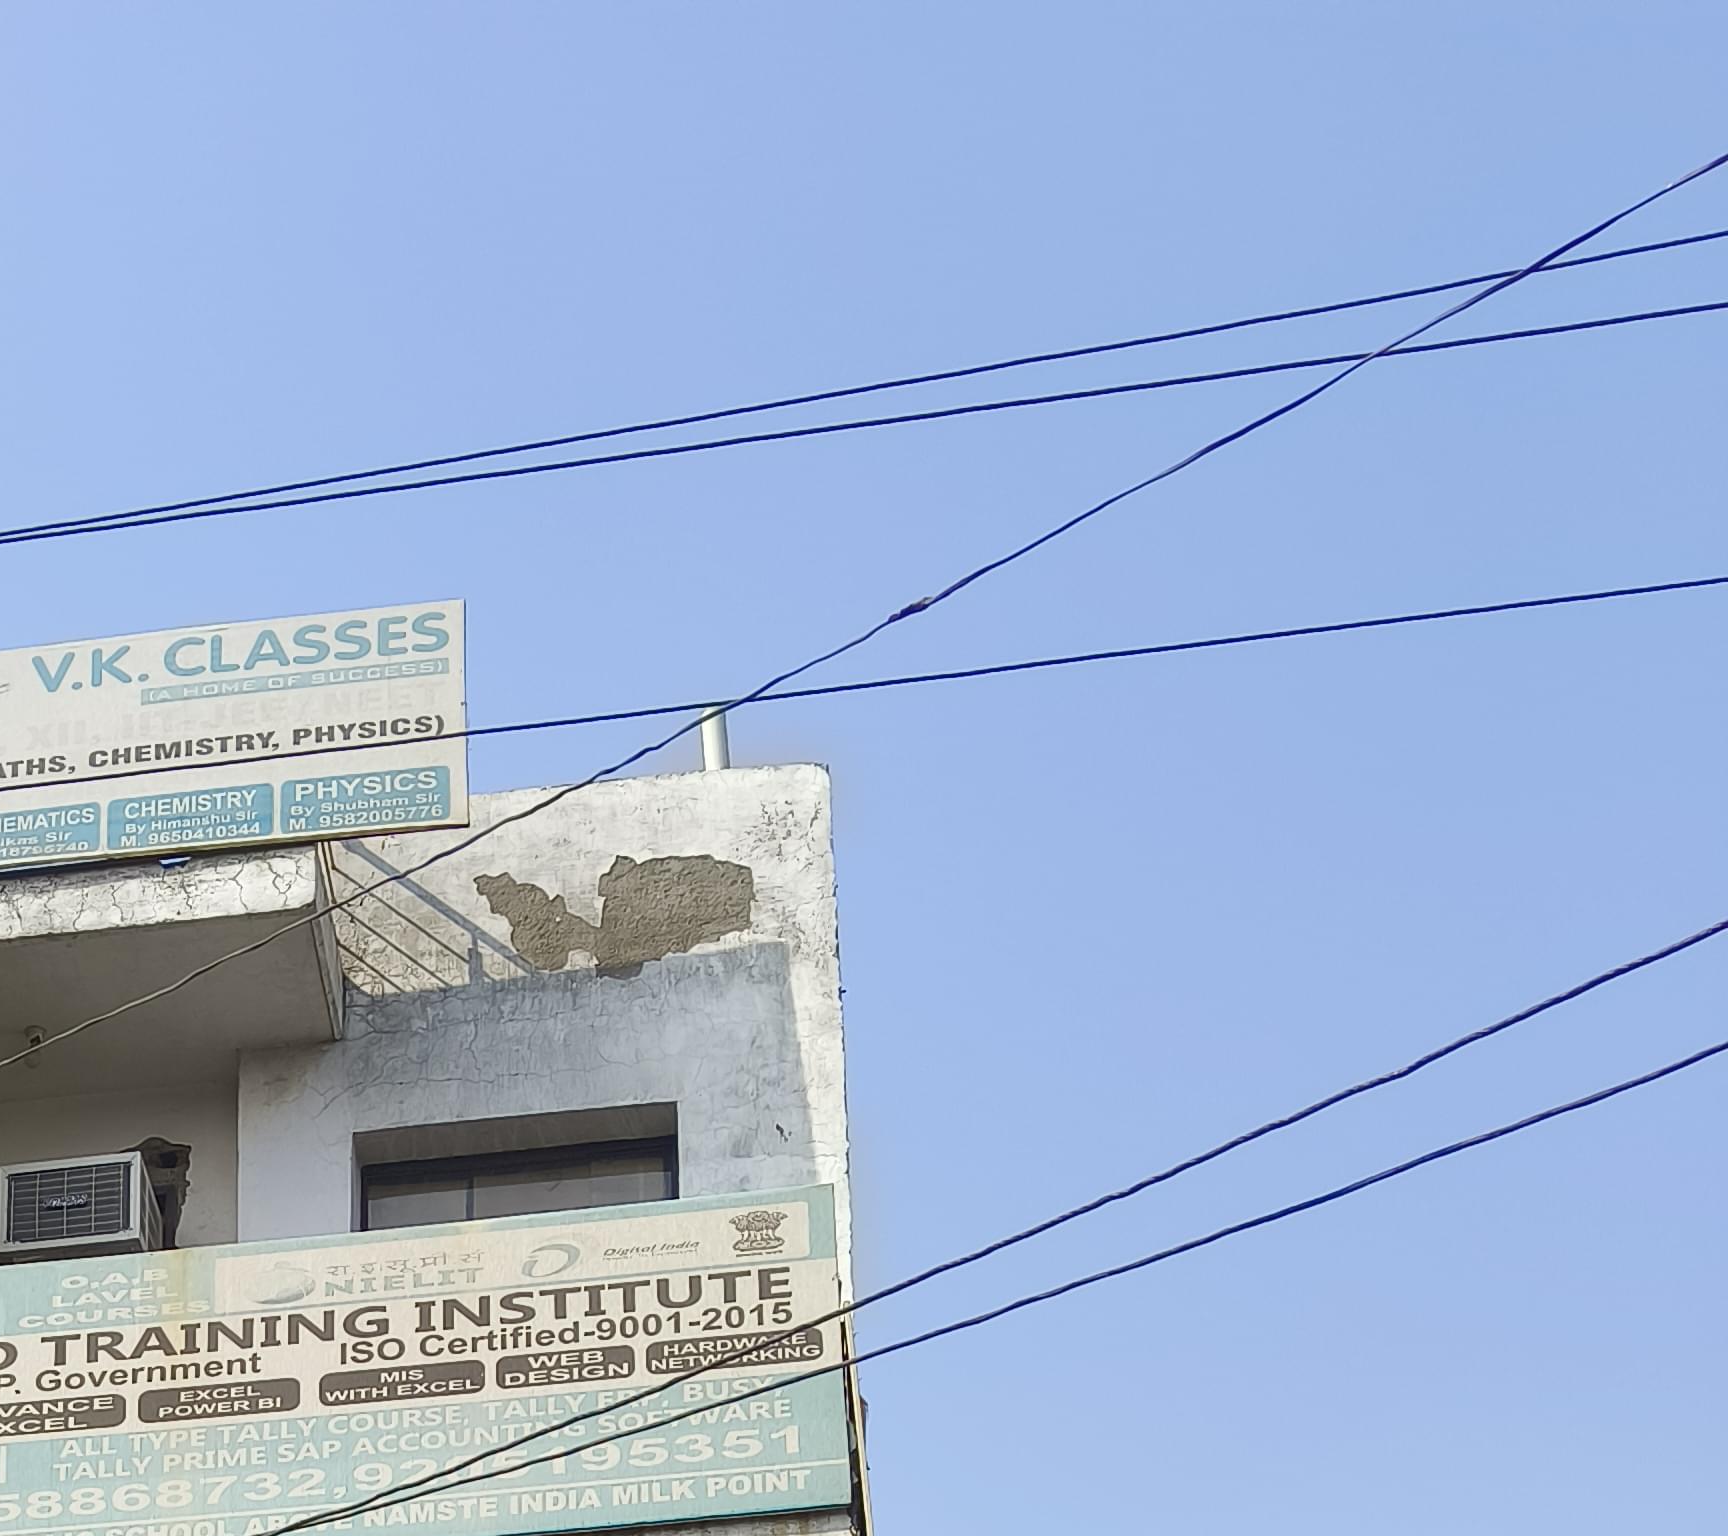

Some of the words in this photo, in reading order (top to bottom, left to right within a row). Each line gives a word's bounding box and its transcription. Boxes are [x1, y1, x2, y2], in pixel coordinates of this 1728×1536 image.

[32, 644, 149, 694] V.K.
[164, 612, 450, 677] CLASSES
[88, 731, 279, 769] CHEMISTRY,
[293, 715, 445, 747] PHYSICS)
[36, 1352, 262, 1393] Government
[340, 1337, 406, 1366] ISO
[419, 1302, 793, 1356] Certified-9001-2015
[41, 1304, 389, 1366] TRAINING
[414, 1266, 793, 1334] INSTITUTE
